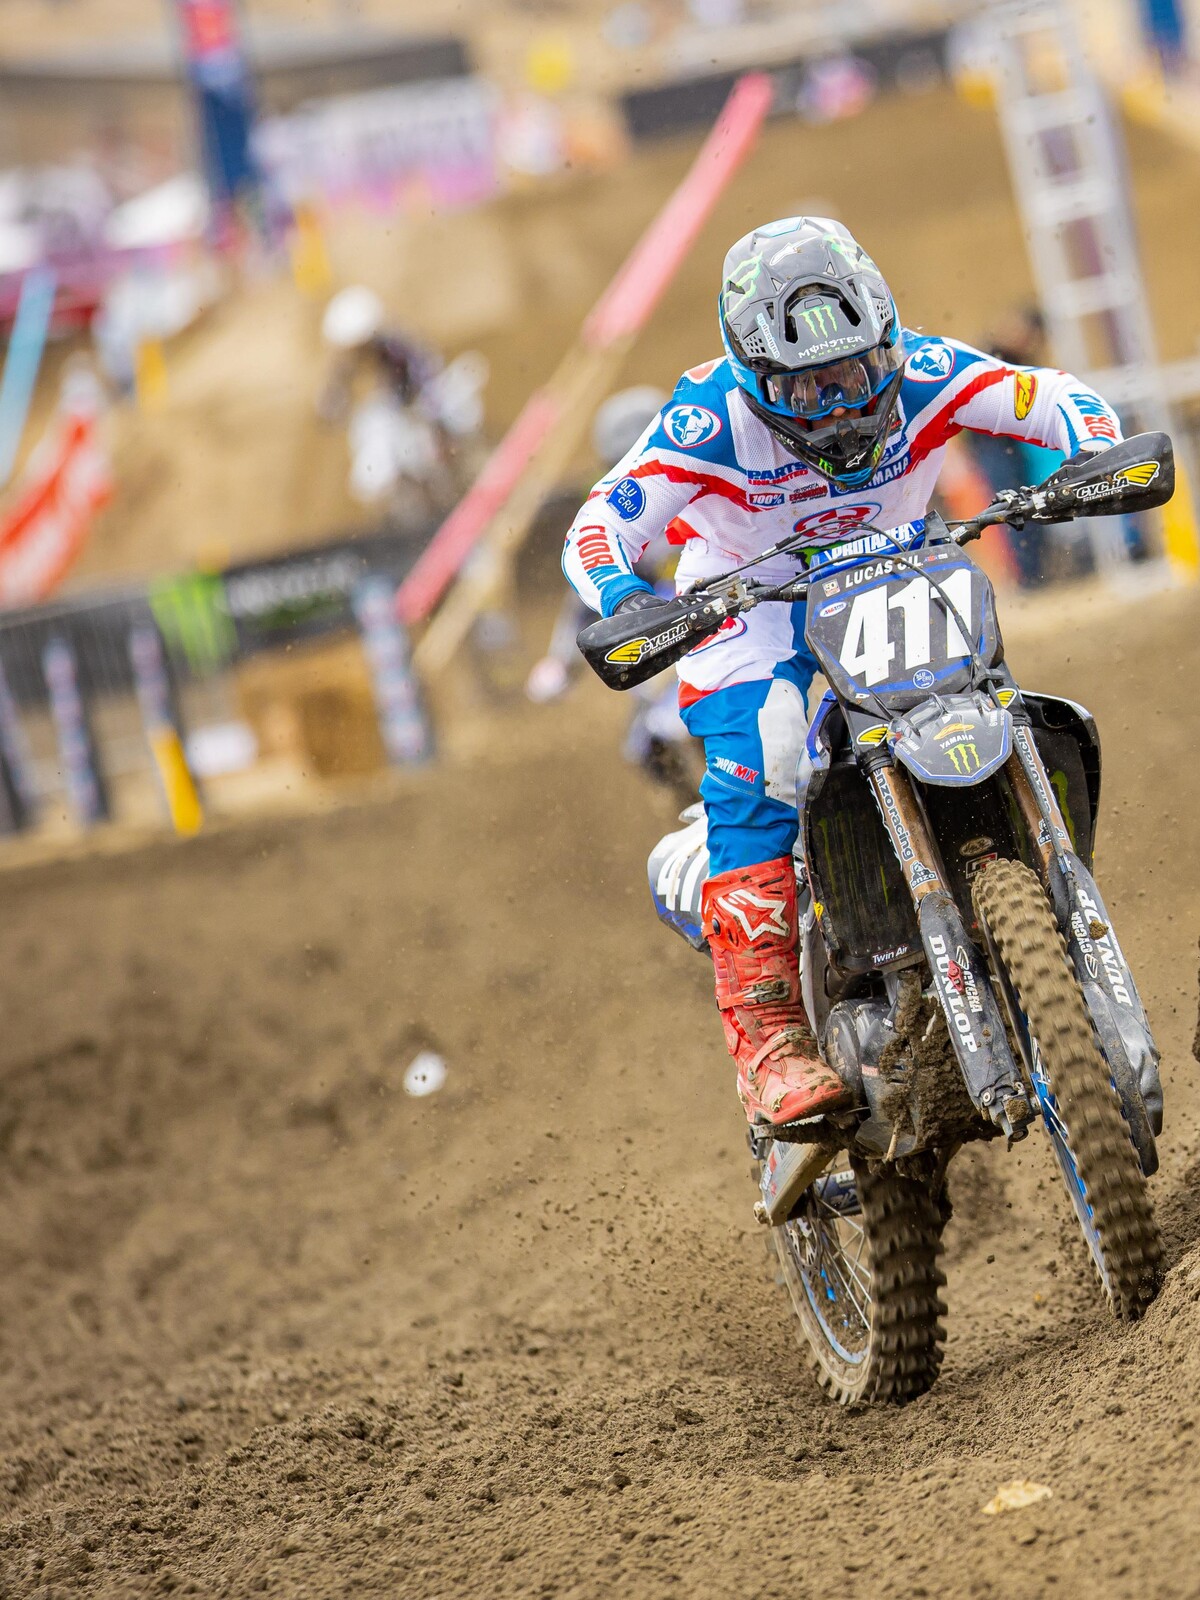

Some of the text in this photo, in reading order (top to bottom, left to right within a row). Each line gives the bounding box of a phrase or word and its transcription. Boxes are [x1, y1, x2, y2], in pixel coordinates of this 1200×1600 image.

[798, 335, 865, 358] MONSTER
[810, 344, 857, 360] ENERGY
[747, 462, 809, 481] PARTS
[866, 455, 909, 488] MAHA
[752, 493, 783, 504] 100%
[845, 560, 893, 588] LUCAS
[641, 621, 690, 655] CYCRA
[839, 568, 972, 687] 411
[939, 734, 975, 749] YAMAHA
[657, 842, 710, 912] 41
[910, 873, 937, 889] enzo
[1071, 911, 1093, 953] CYCRA
[872, 945, 908, 964] Twin Air
[929, 934, 978, 1053] DUNLOP
[962, 970, 983, 1014] CYCRA
